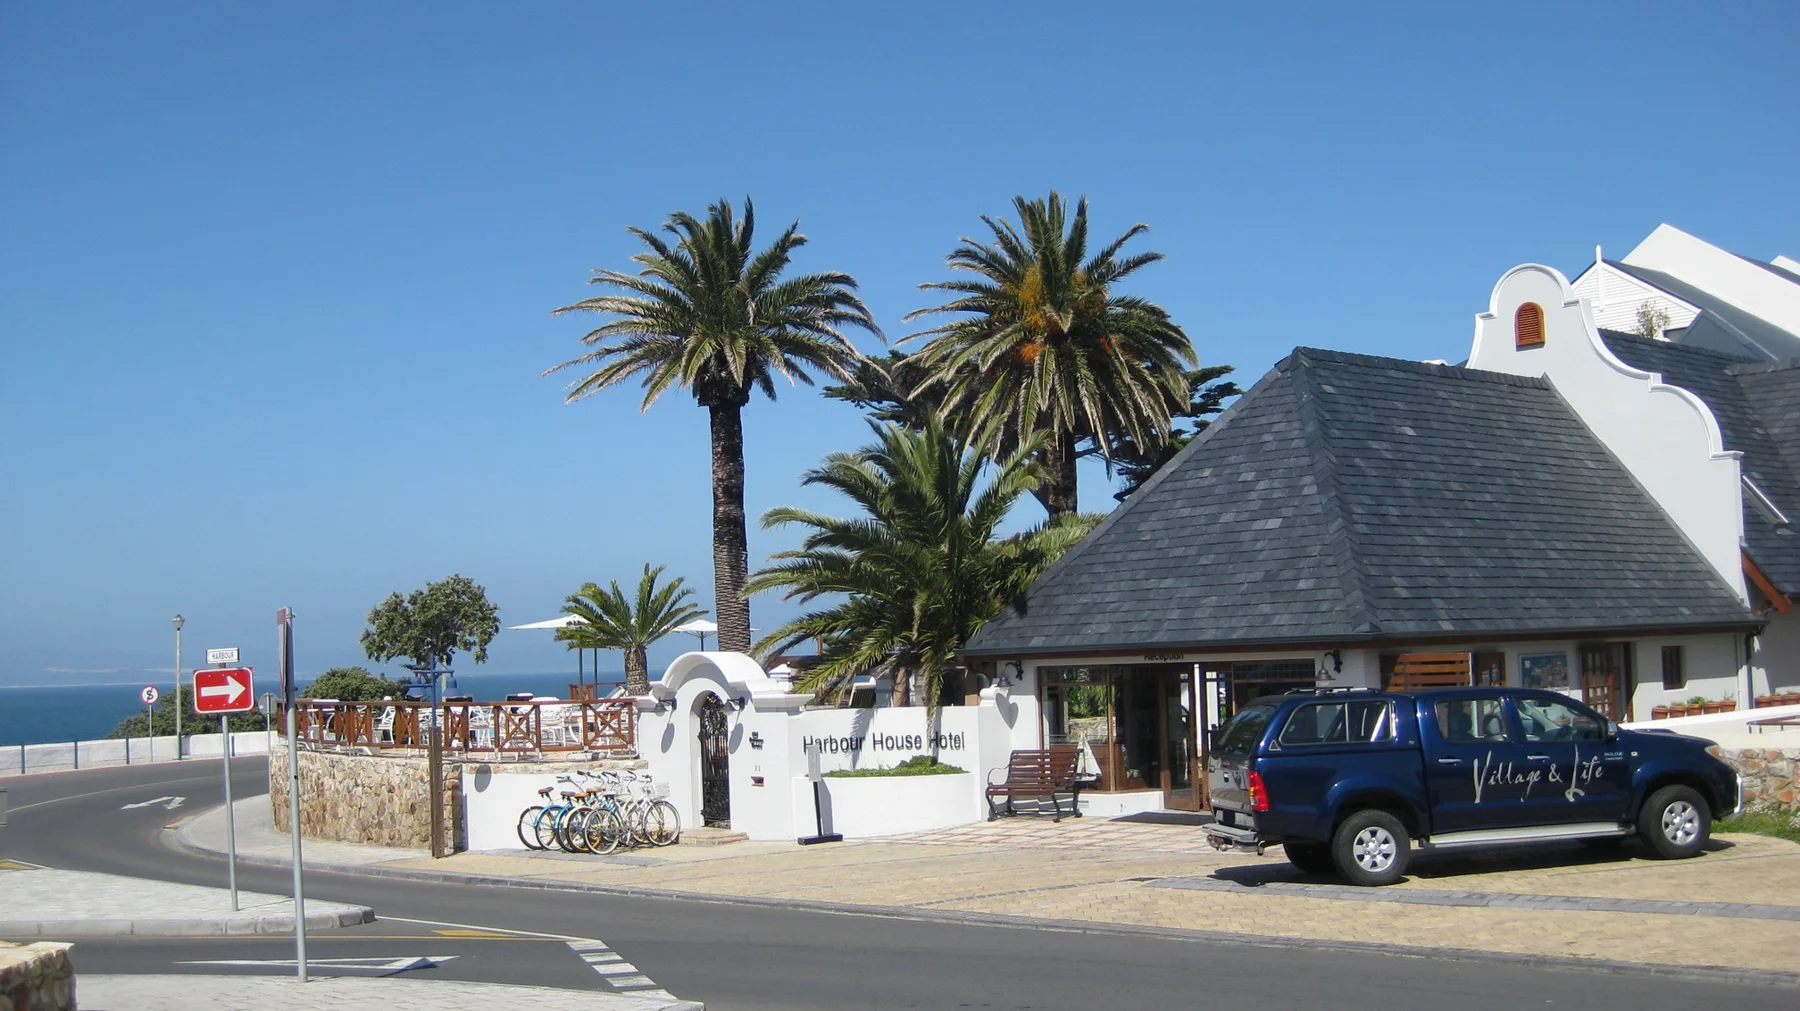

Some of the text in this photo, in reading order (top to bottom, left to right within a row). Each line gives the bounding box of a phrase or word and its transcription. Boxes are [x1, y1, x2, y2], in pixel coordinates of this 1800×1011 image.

[211, 651, 235, 660] HARBOUR
[803, 731, 965, 755] Harbour House Hotel
[1473, 743, 1603, 804] Village & Life
